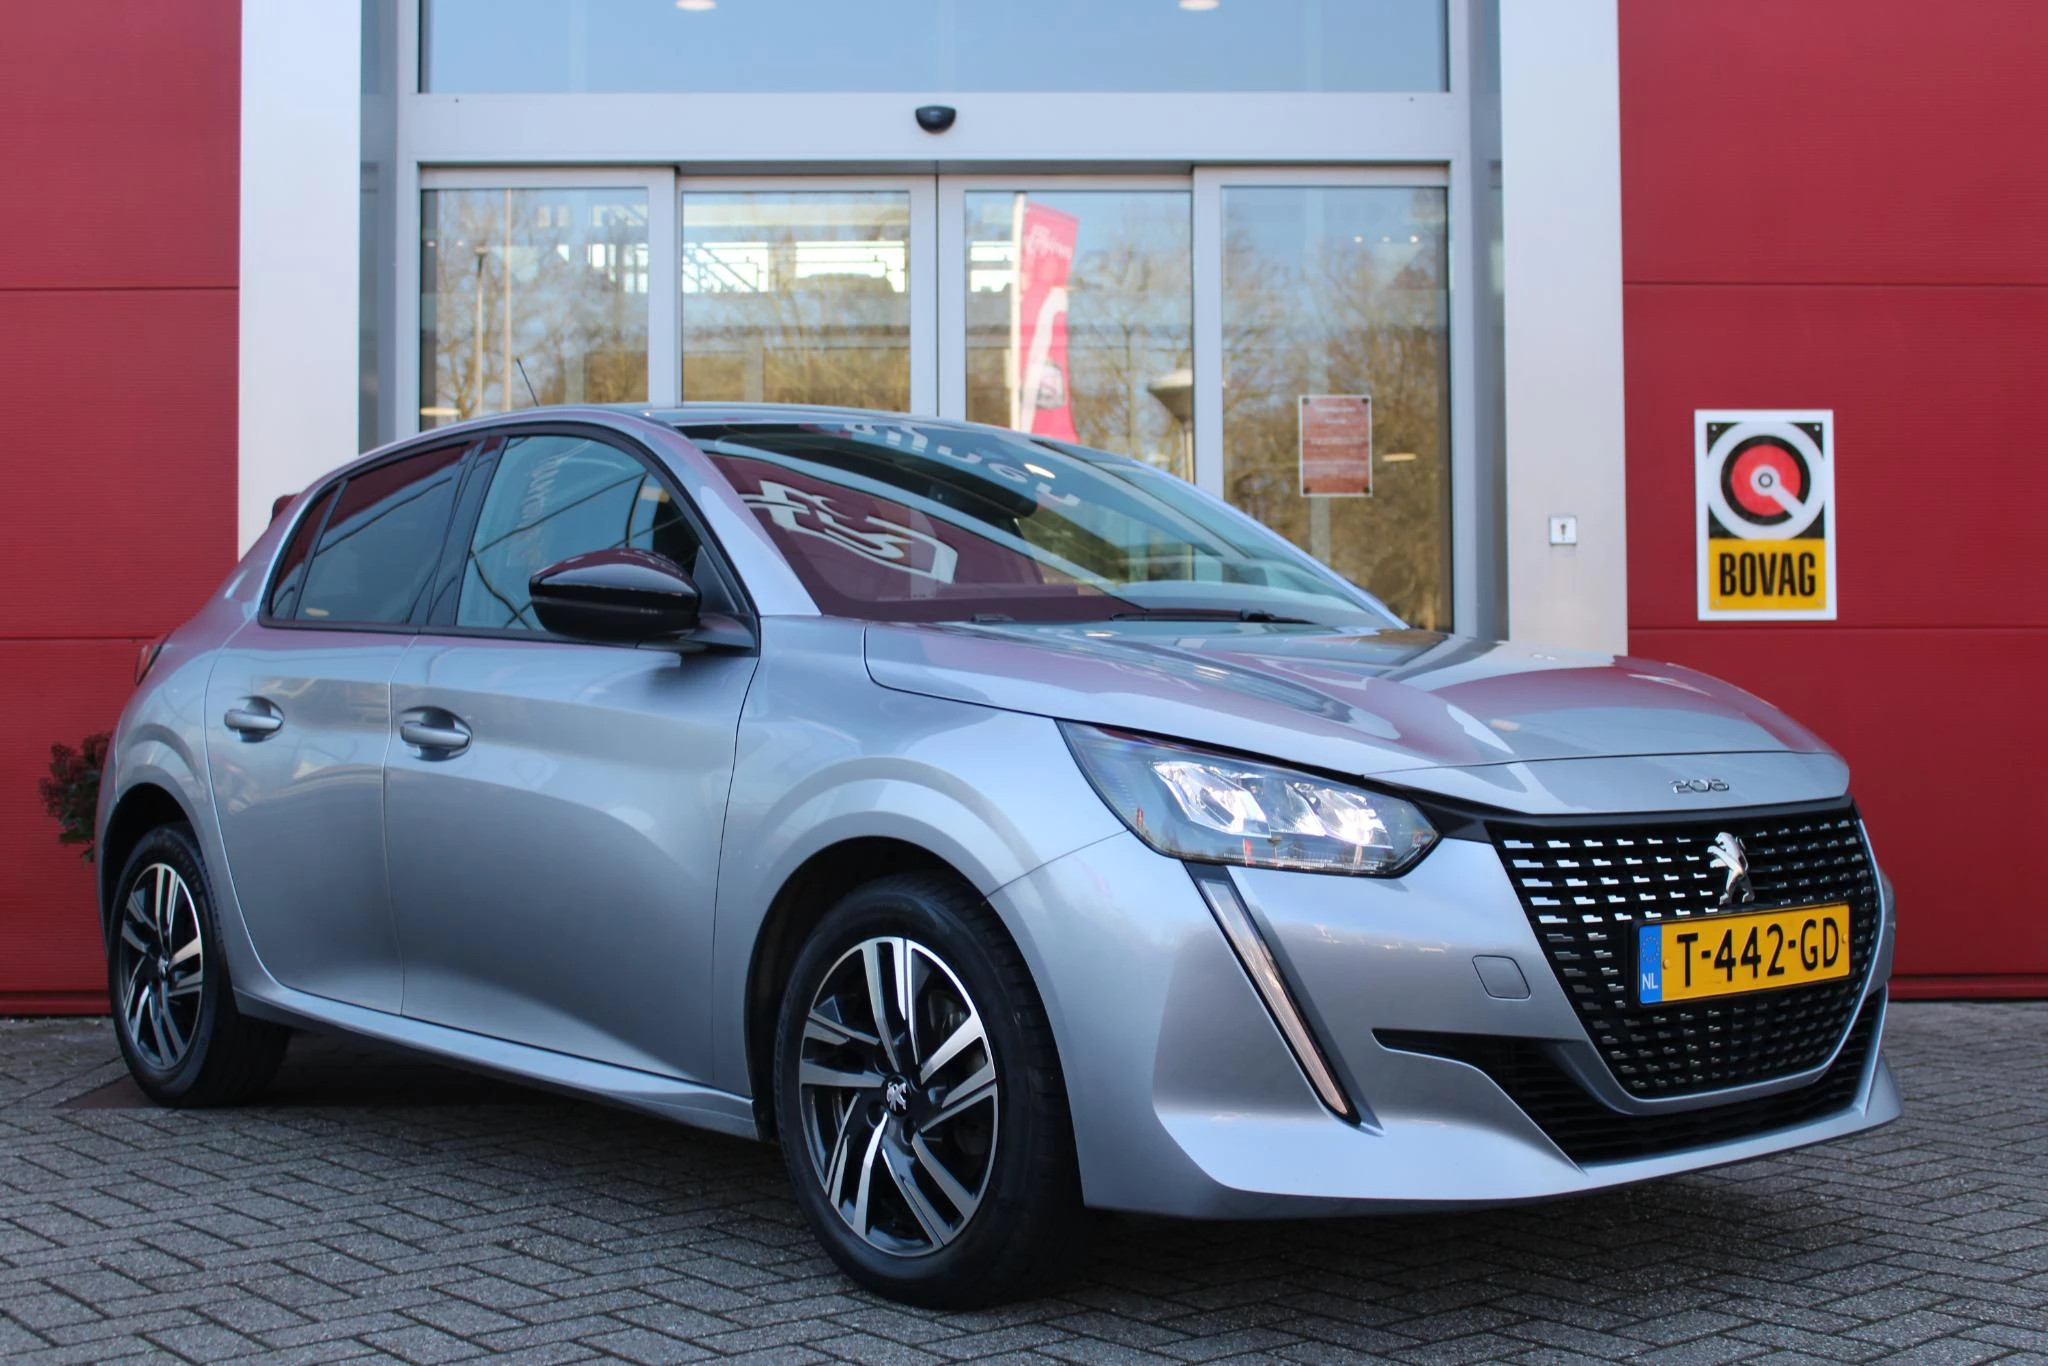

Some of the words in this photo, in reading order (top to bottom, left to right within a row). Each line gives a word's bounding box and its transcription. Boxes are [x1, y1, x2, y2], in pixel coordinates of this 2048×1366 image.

[1720, 552, 1816, 597] BOVAG
[1676, 917, 1840, 987] T-442-GD
[1642, 974, 1659, 990] NL
